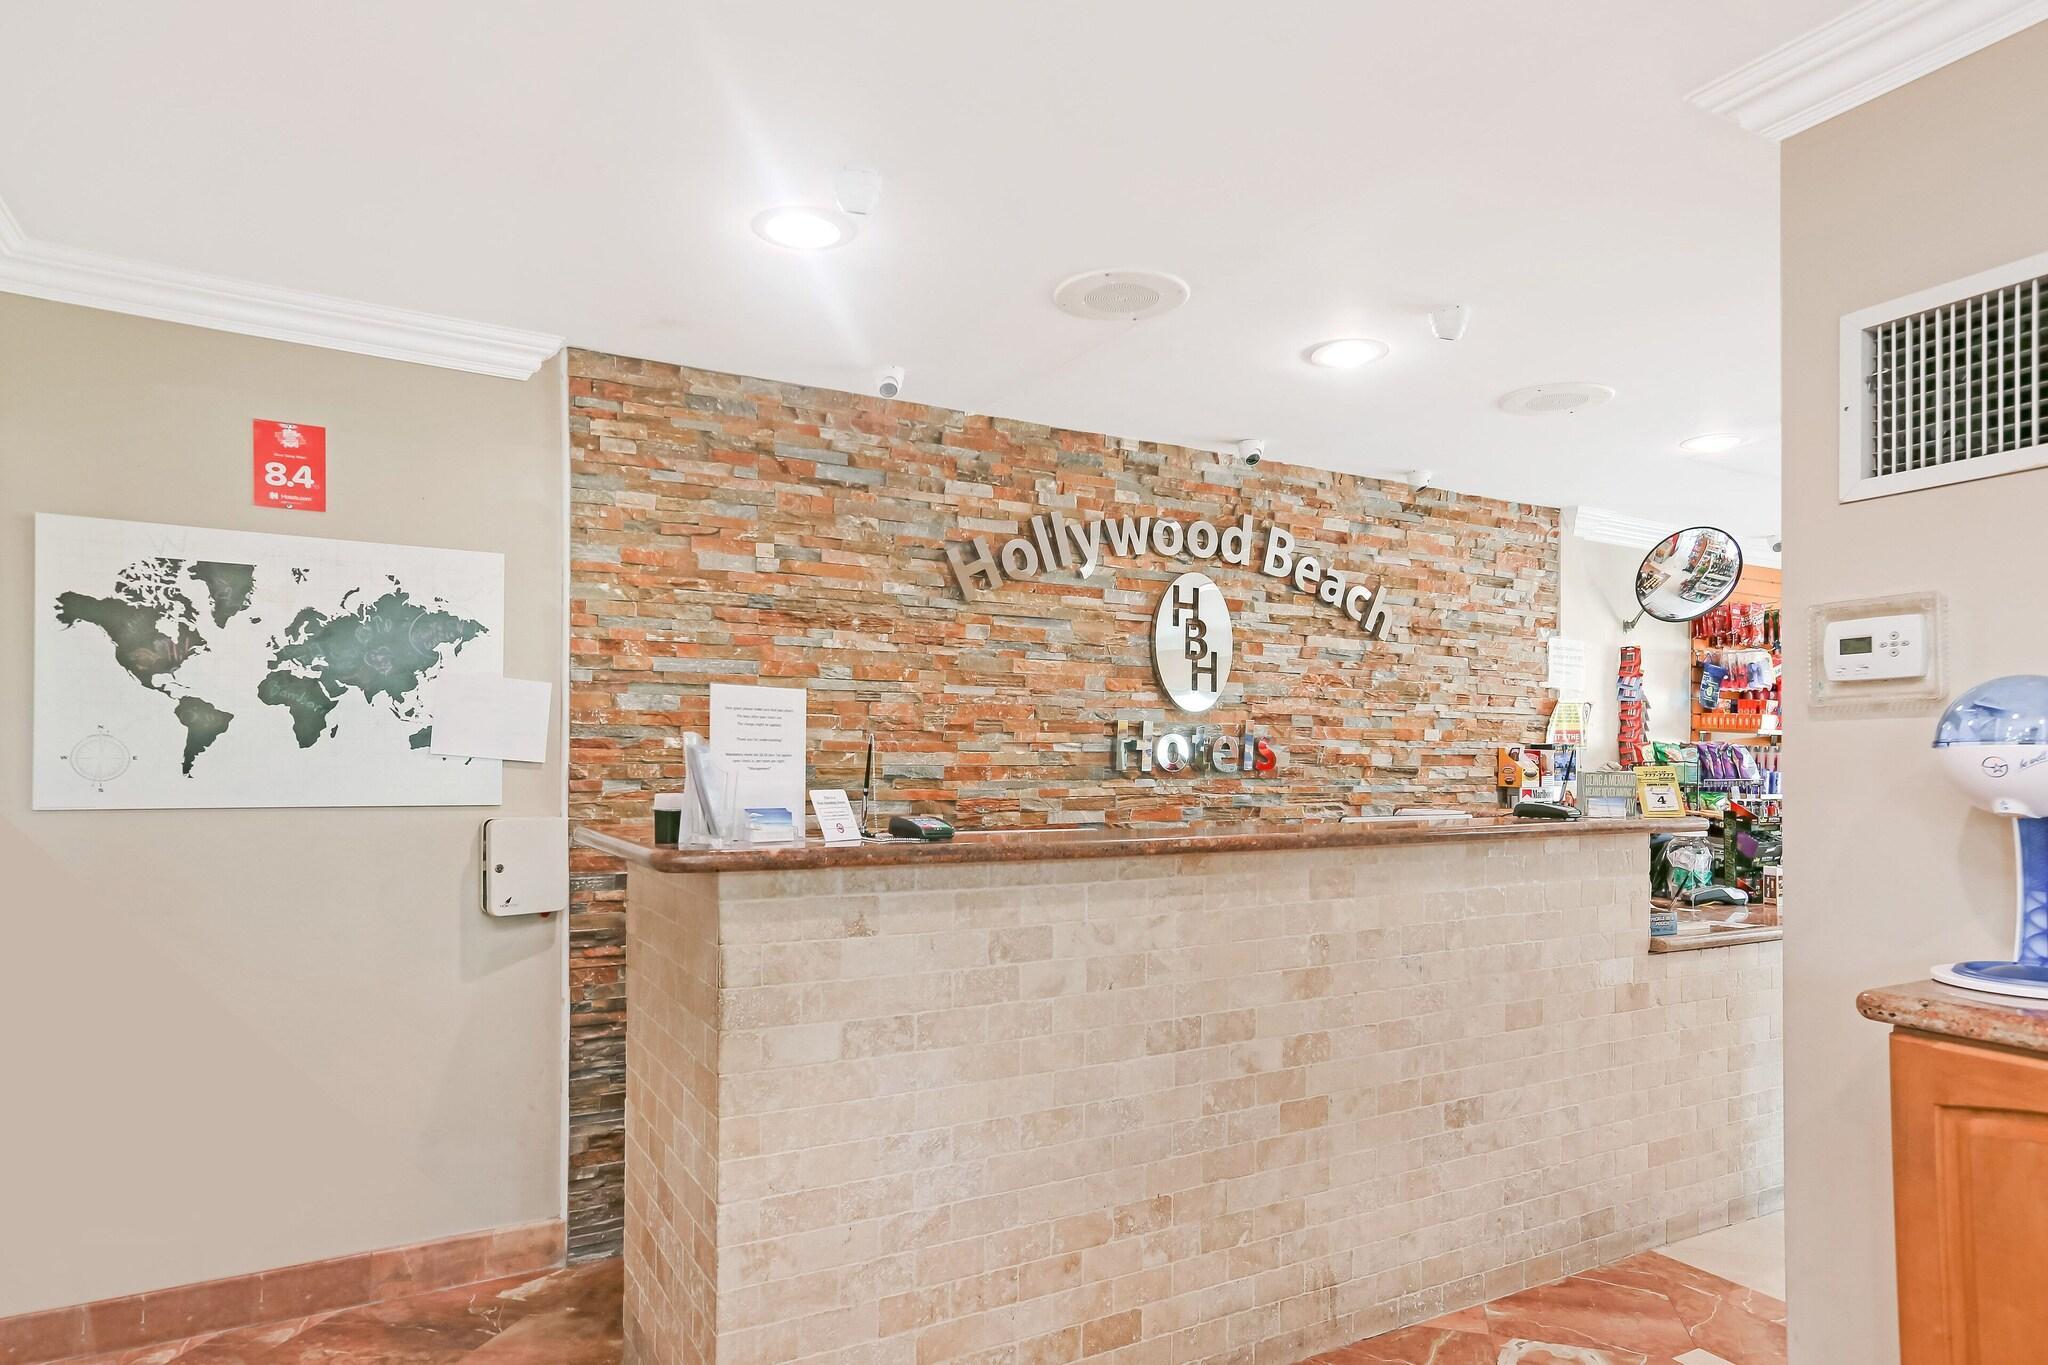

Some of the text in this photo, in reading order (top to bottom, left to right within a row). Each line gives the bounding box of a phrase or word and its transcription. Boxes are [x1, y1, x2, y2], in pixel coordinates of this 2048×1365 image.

[264, 461, 315, 489] 8.4
[944, 510, 1395, 642] Hollywood Beach
[1114, 719, 1277, 774] Hotels
[1585, 773, 1603, 786] BEING
[1603, 773, 1608, 786] A
[1608, 773, 1636, 786] MERMAID
[1601, 786, 1616, 797] NEVER
[1656, 795, 1667, 805] 4
